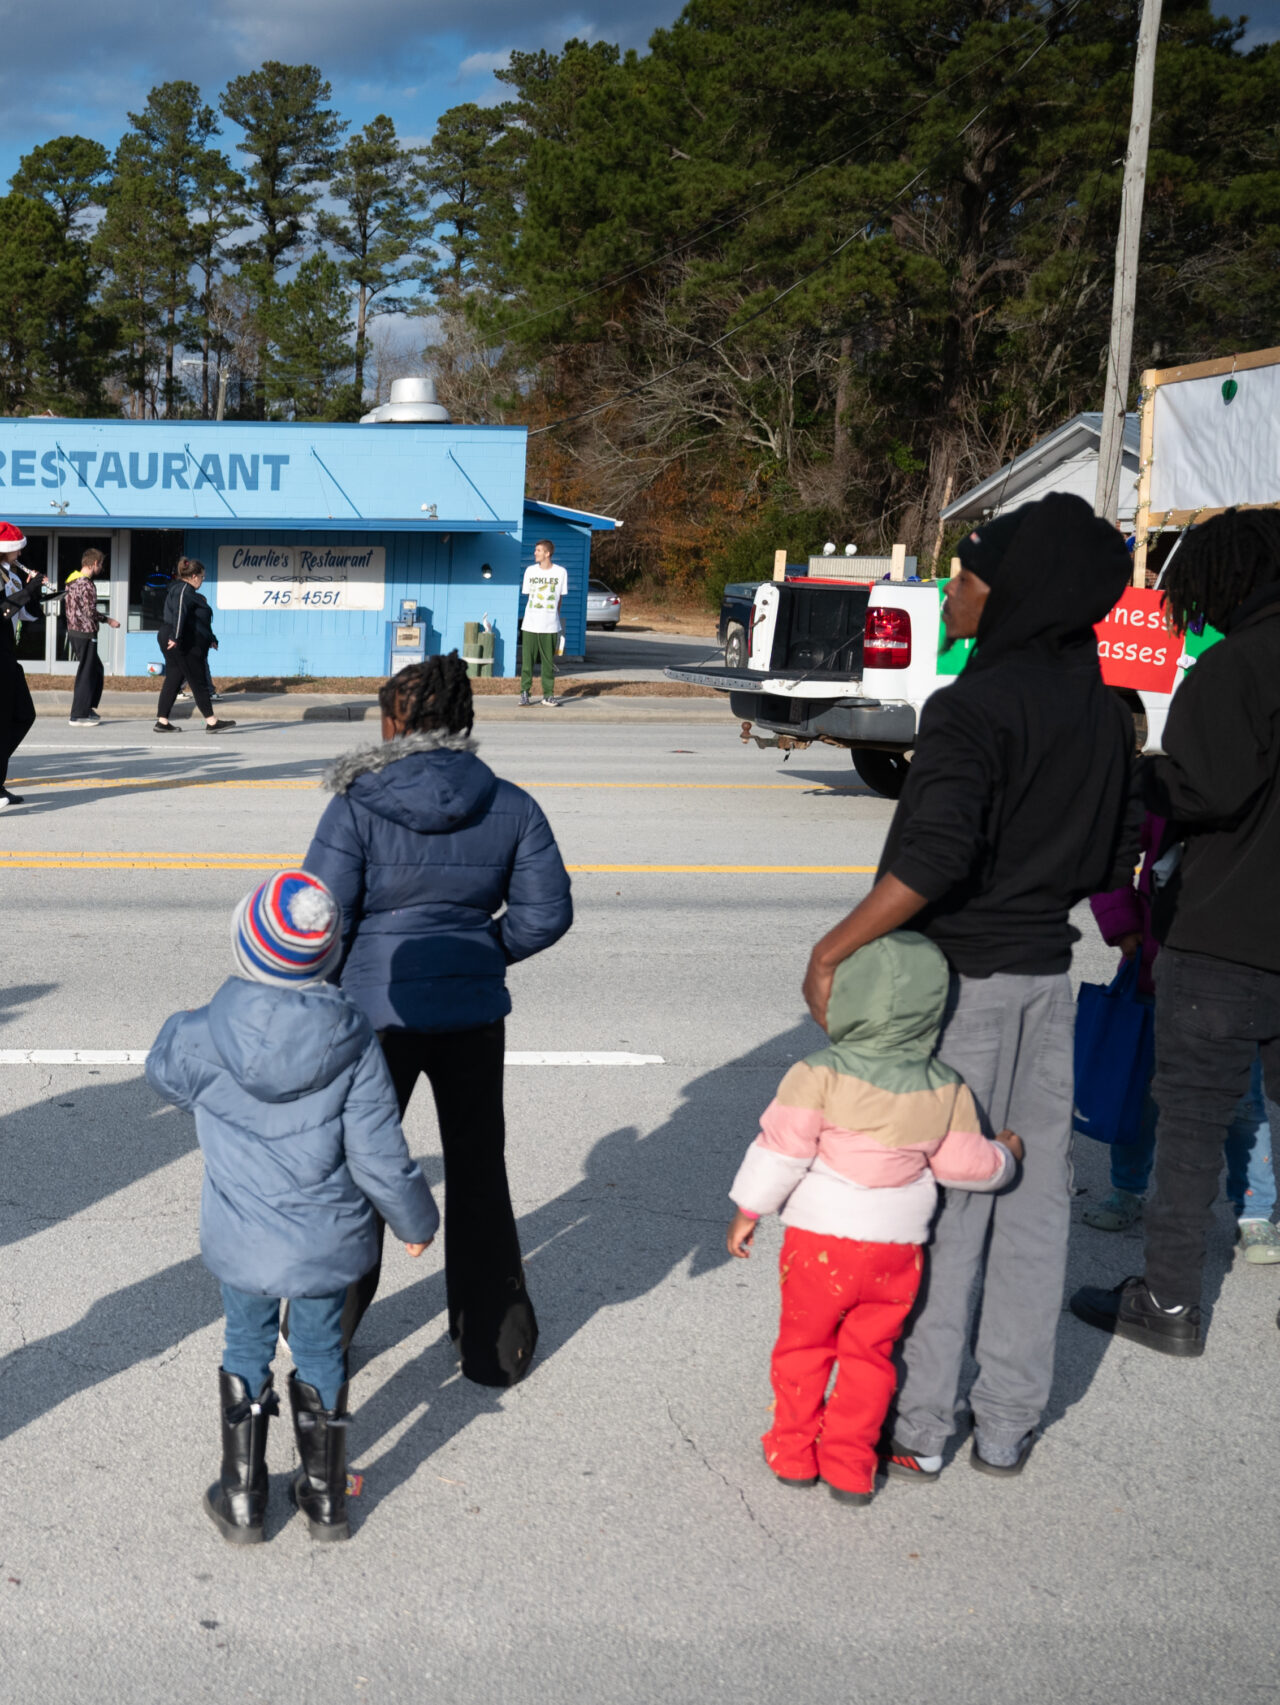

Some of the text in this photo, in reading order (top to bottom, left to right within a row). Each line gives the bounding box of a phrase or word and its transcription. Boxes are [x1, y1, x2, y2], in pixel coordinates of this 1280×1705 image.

[232, 548, 373, 571] Charlie's Restaurant
[1097, 640, 1167, 665] asses
